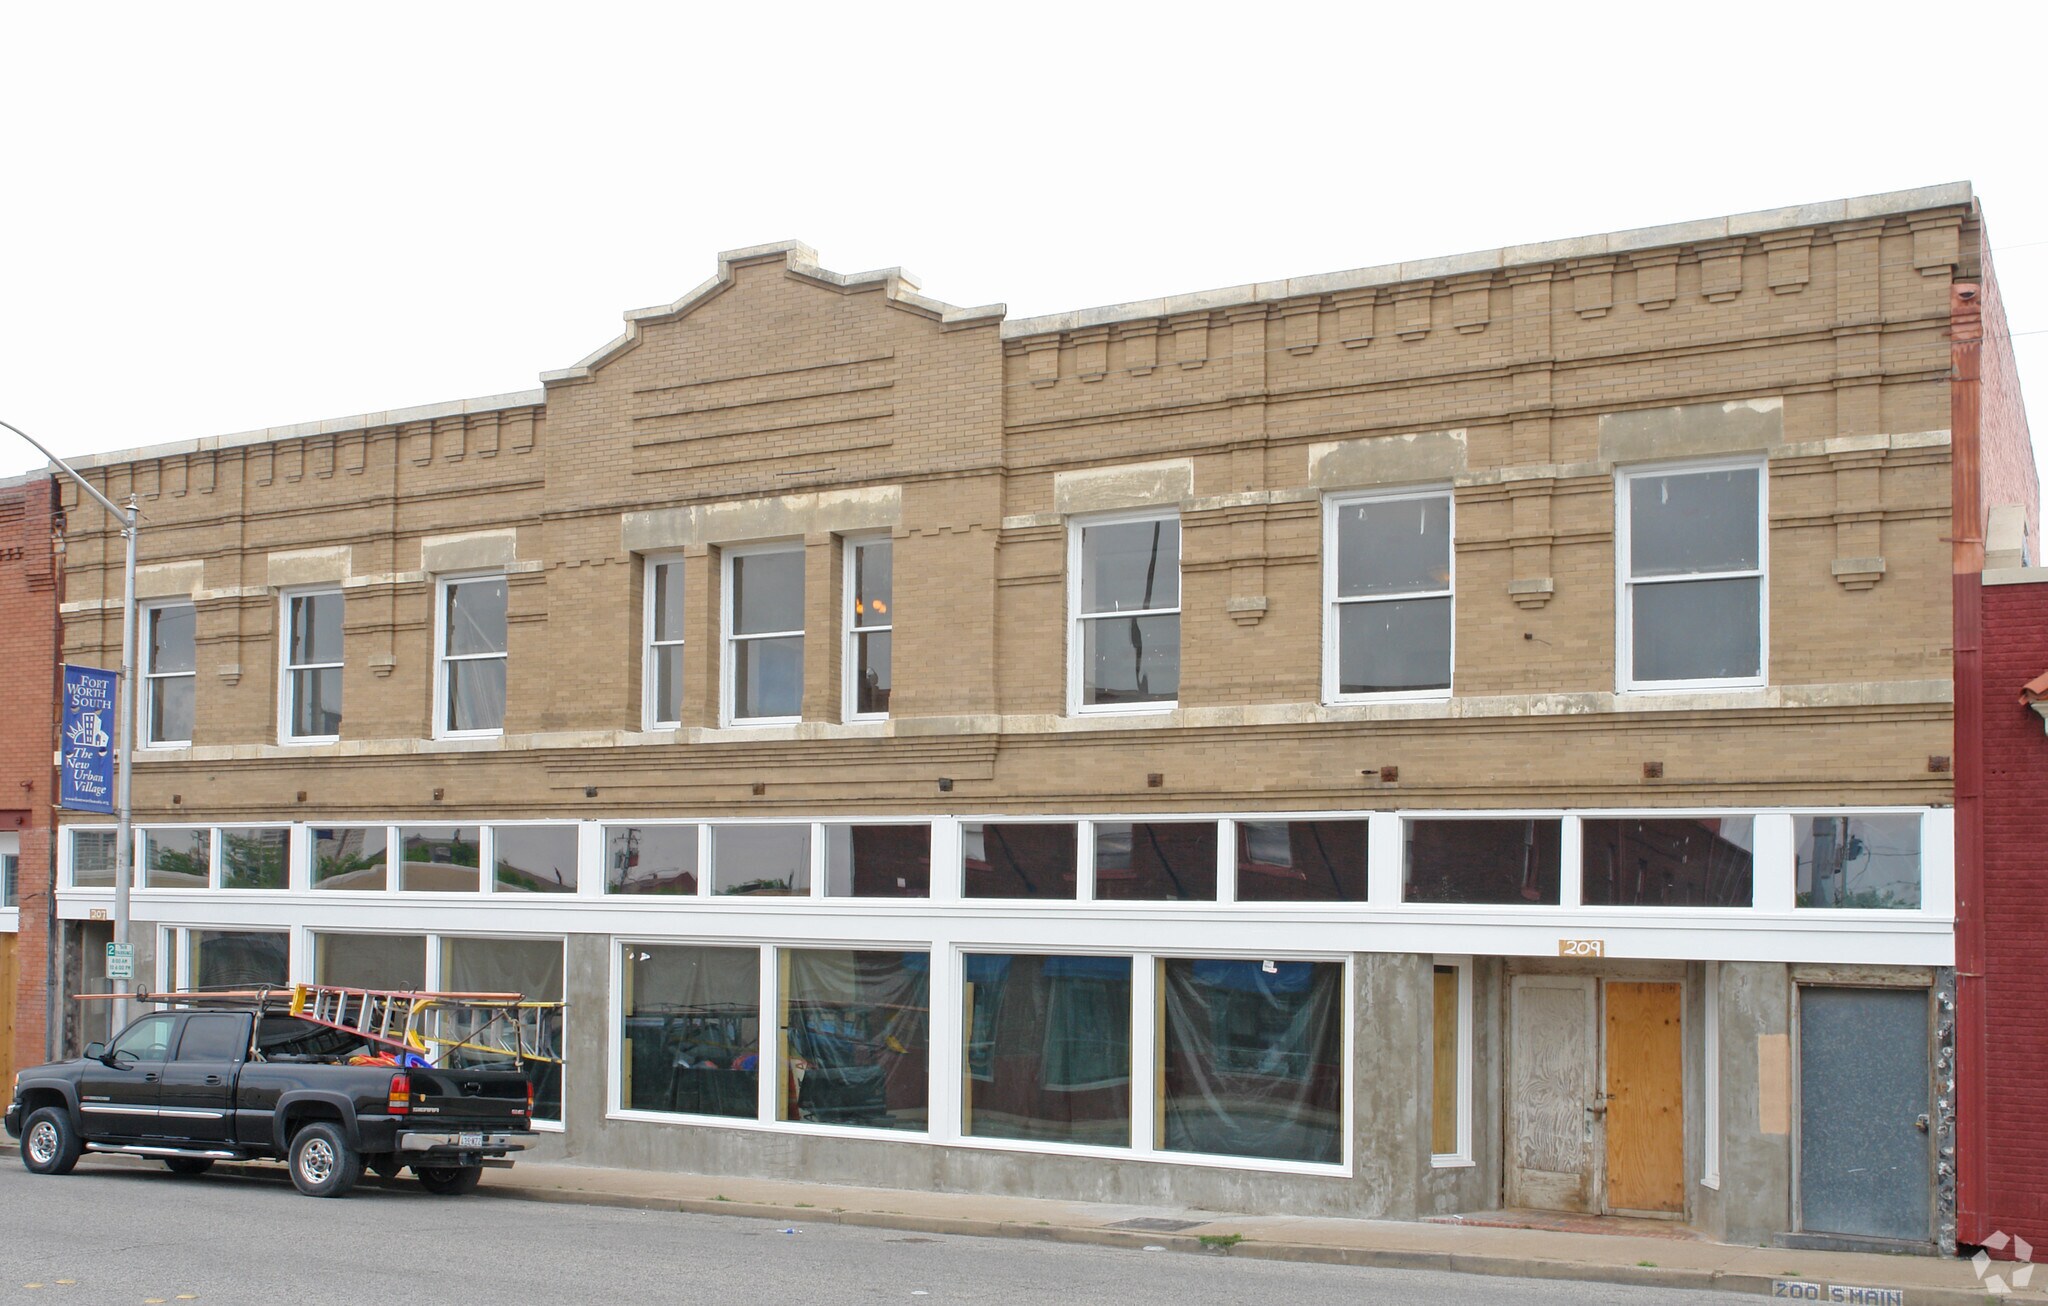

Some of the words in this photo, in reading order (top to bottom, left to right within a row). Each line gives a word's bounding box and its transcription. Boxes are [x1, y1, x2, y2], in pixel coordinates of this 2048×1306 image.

[81, 675, 109, 689] FORT
[67, 683, 106, 698] WORTH
[72, 694, 111, 709] SOUTH
[74, 747, 93, 759] The
[66, 758, 90, 769] New
[74, 769, 104, 782] Urban
[74, 780, 107, 797] Village
[91, 910, 106, 920] 207
[108, 945, 115, 955] 2
[1564, 940, 1601, 957] 209
[1775, 1283, 1819, 1300] 200
[1831, 1287, 1845, 1303] S
[1849, 1289, 1902, 1306] MAIN
